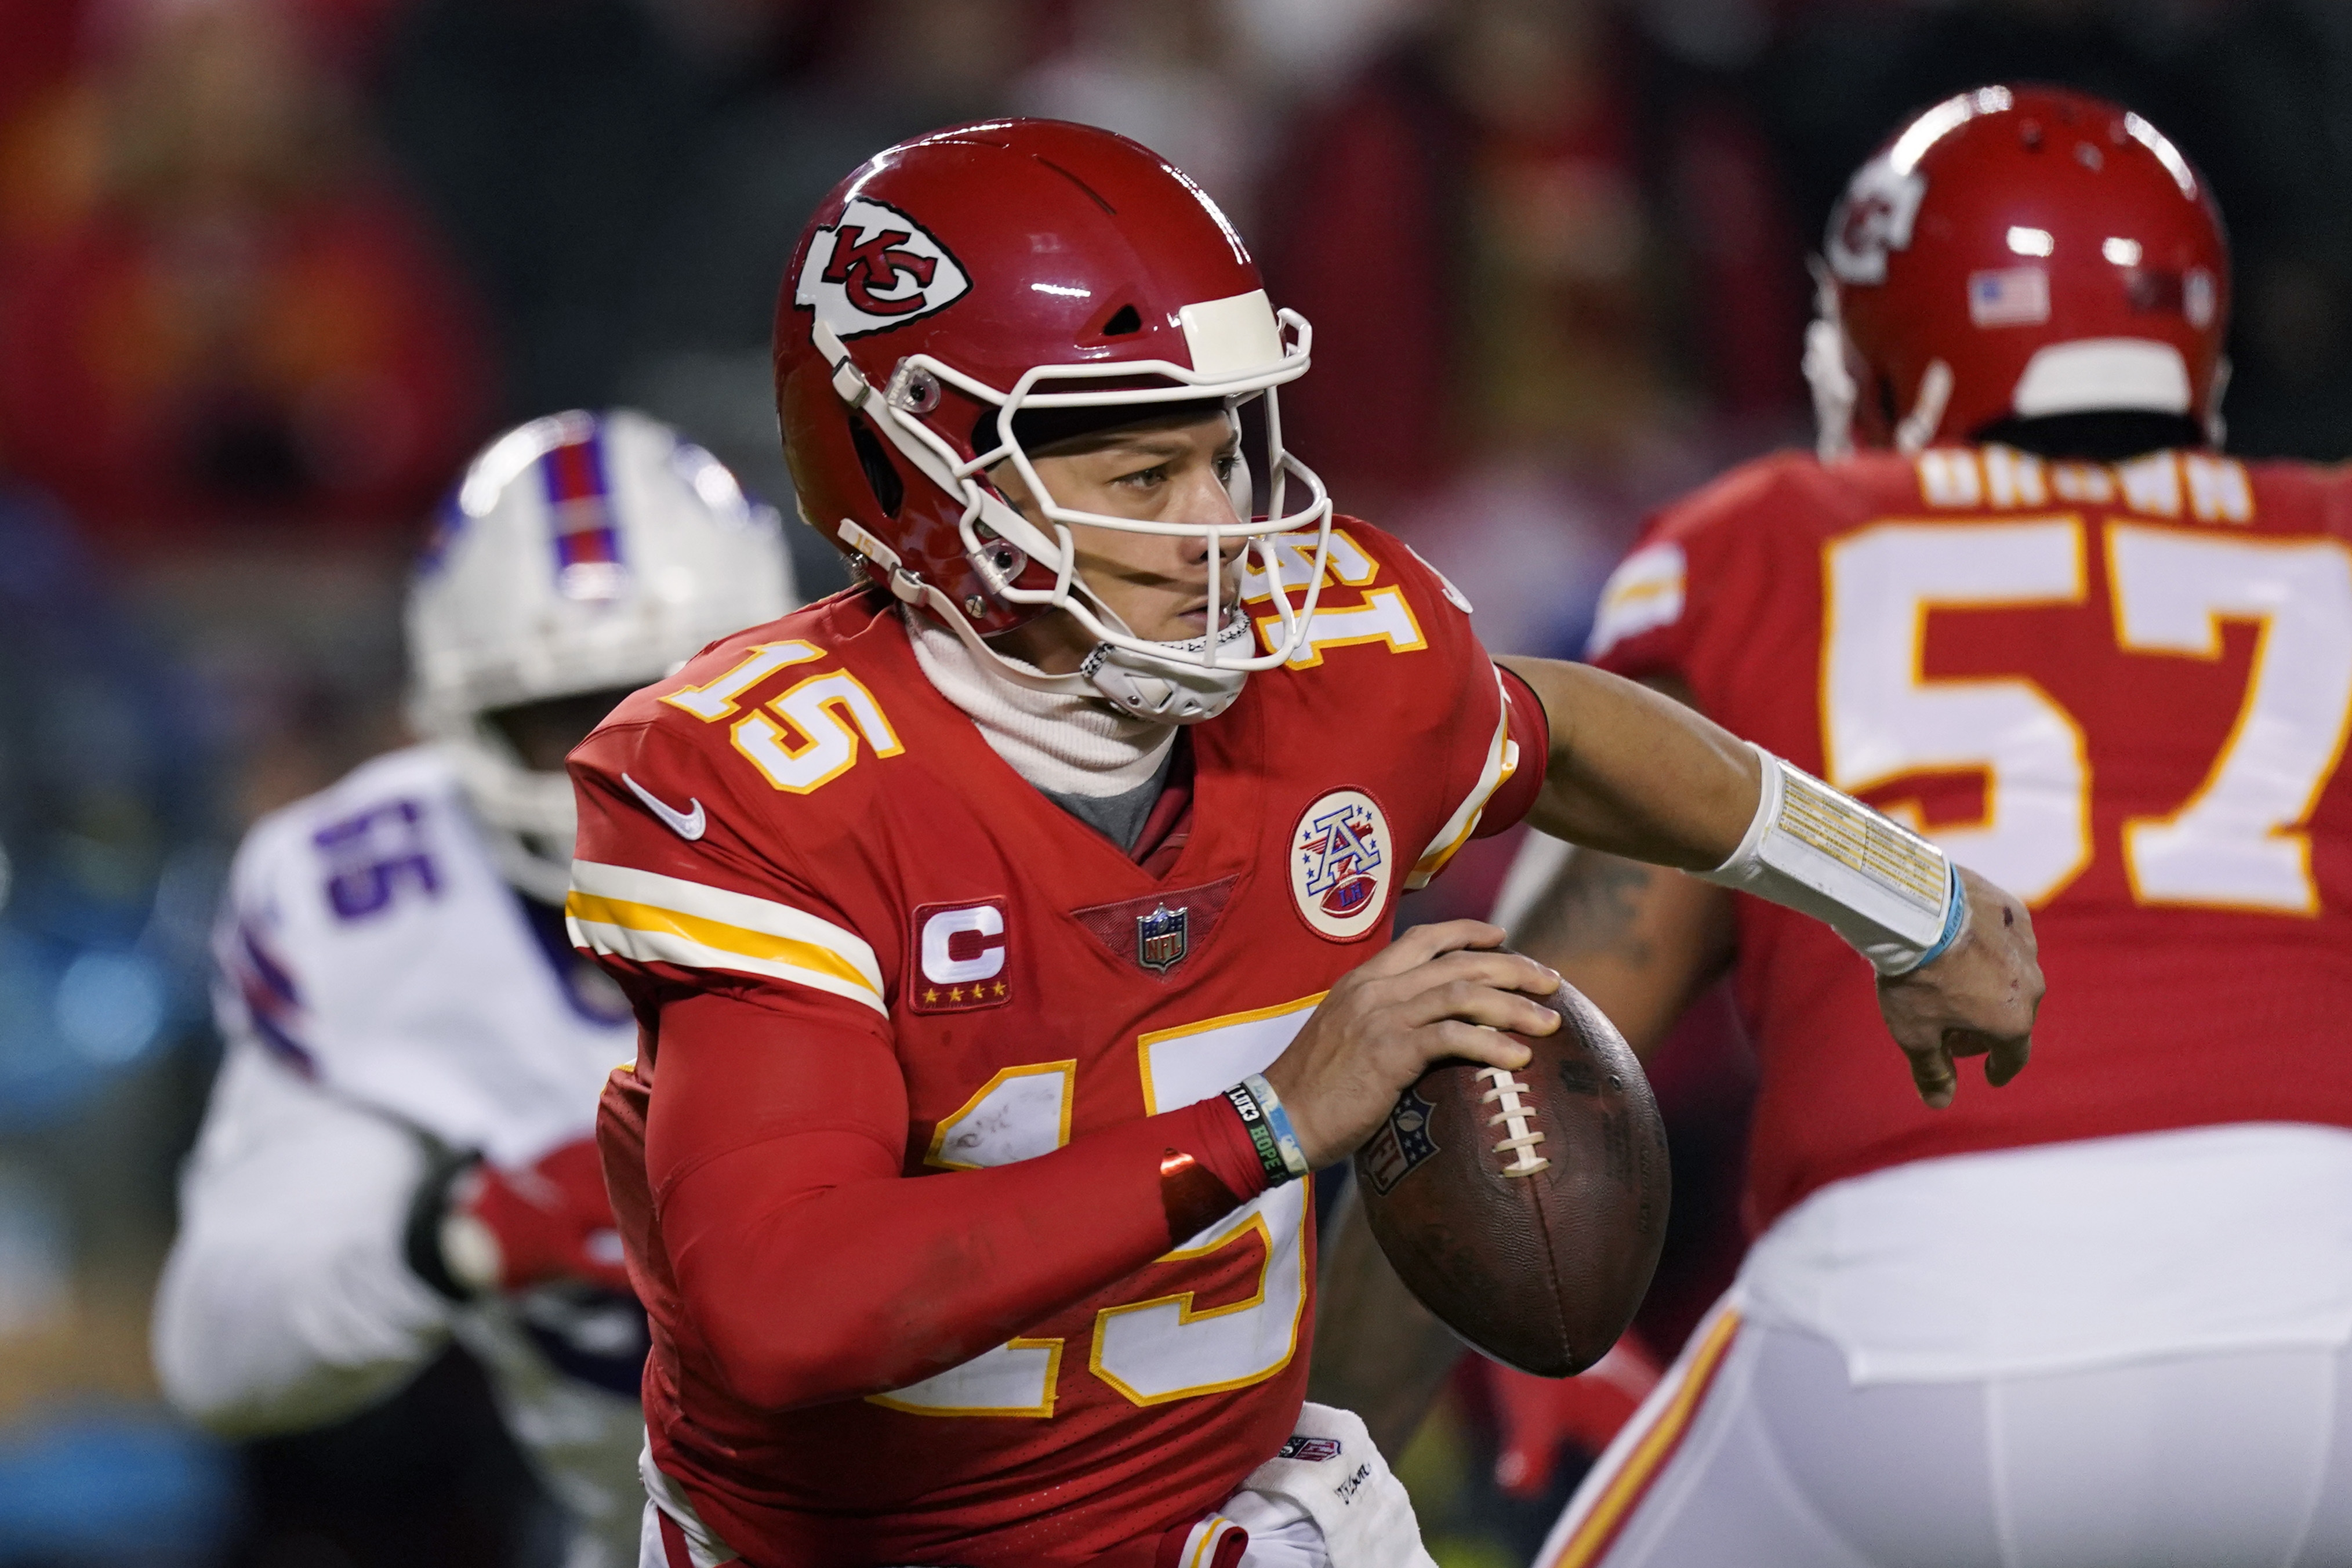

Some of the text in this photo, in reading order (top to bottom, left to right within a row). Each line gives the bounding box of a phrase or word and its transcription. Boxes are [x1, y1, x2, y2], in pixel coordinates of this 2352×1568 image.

[821, 225, 938, 317] KC
[853, 533, 876, 557] 15
[659, 638, 906, 795] 15
[1817, 511, 2352, 921] 57
[1306, 804, 1381, 897] A
[1339, 881, 1364, 907] LH
[922, 905, 1006, 985] C
[1145, 932, 1181, 960] NFL
[1229, 1088, 1261, 1122] LUK3
[1250, 1123, 1282, 1171] HOPE
